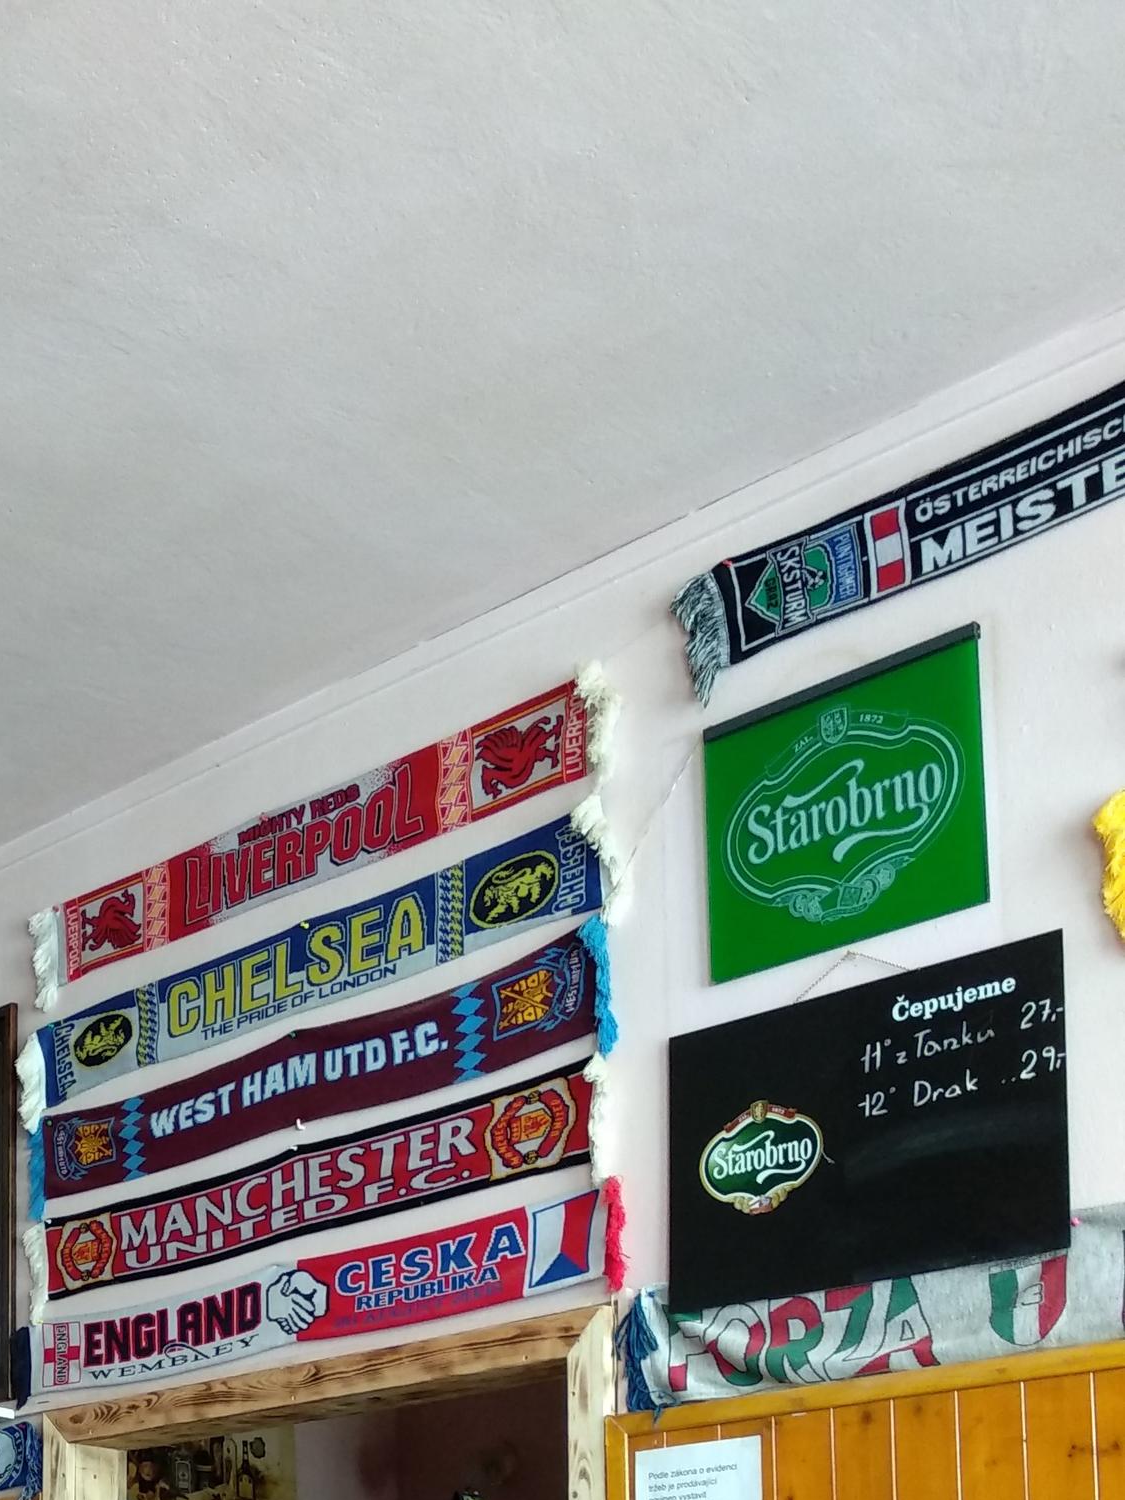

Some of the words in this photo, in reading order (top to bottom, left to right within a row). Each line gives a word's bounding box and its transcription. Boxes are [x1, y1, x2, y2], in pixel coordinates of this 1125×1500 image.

[915, 414, 1125, 524] ÖSTERREICHISC
[185, 763, 425, 926] LIVERPOOL
[238, 805, 306, 846] MIGHTY
[309, 784, 360, 820] REDS
[747, 758, 942, 865] Starobrno
[166, 891, 428, 1038] CHELSEA
[201, 1022, 234, 1041] THE
[237, 1005, 288, 1030] PRIDE
[292, 994, 316, 1009] OF
[319, 963, 397, 999] LONDON
[892, 977, 1017, 1022] Čepujeme
[150, 1081, 236, 1139] WEST
[241, 1053, 317, 1108] HAM
[324, 1037, 387, 1082] UTD
[390, 1020, 449, 1065] F.C.
[913, 1069, 979, 1107] Drak
[121, 1117, 477, 1251] MANCHESTER
[713, 1130, 813, 1184] Starobrno
[125, 1193, 349, 1268] UNITED
[364, 1162, 472, 1205] F.C.
[335, 1222, 525, 1296] CESKA
[355, 1265, 500, 1312] REPUBLIKA
[55, 1324, 68, 1385] ENGLAND
[83, 1281, 262, 1368] ENGLAND
[88, 1334, 260, 1381] WEMBLEY
[667, 1276, 941, 1392] FORZA
[706, 1464, 737, 1472] evidenci
